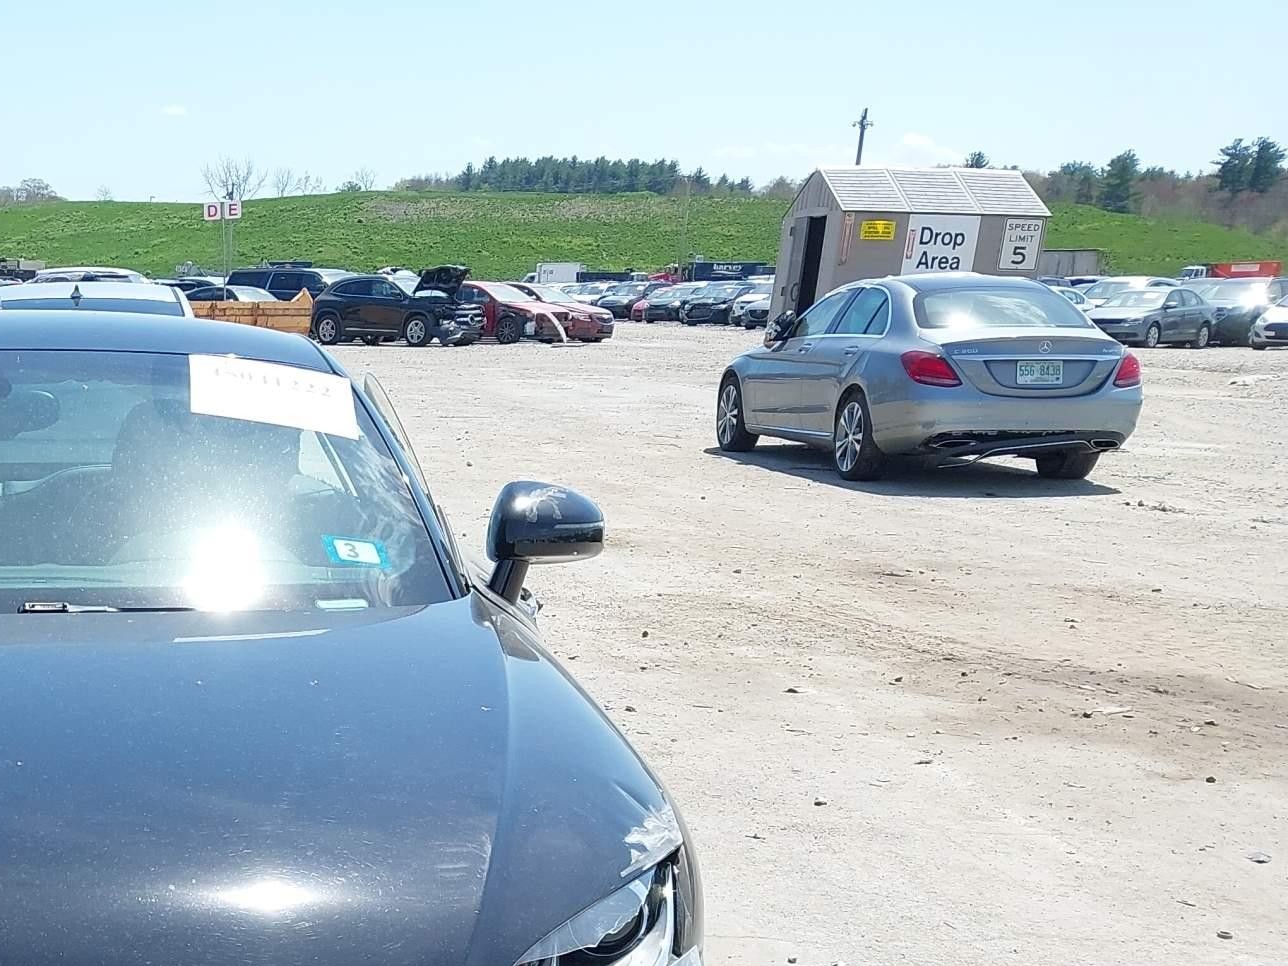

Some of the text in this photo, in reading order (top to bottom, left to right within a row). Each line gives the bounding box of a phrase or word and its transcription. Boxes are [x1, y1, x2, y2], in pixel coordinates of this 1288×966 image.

[208, 204, 238, 217] D E
[1007, 223, 1041, 232] SPEED
[918, 226, 966, 251] Drop
[1008, 234, 1036, 243] LIMIT
[915, 250, 961, 271] Area
[1010, 245, 1027, 265] 5
[1019, 364, 1035, 377] 556
[344, 543, 359, 558] 3
